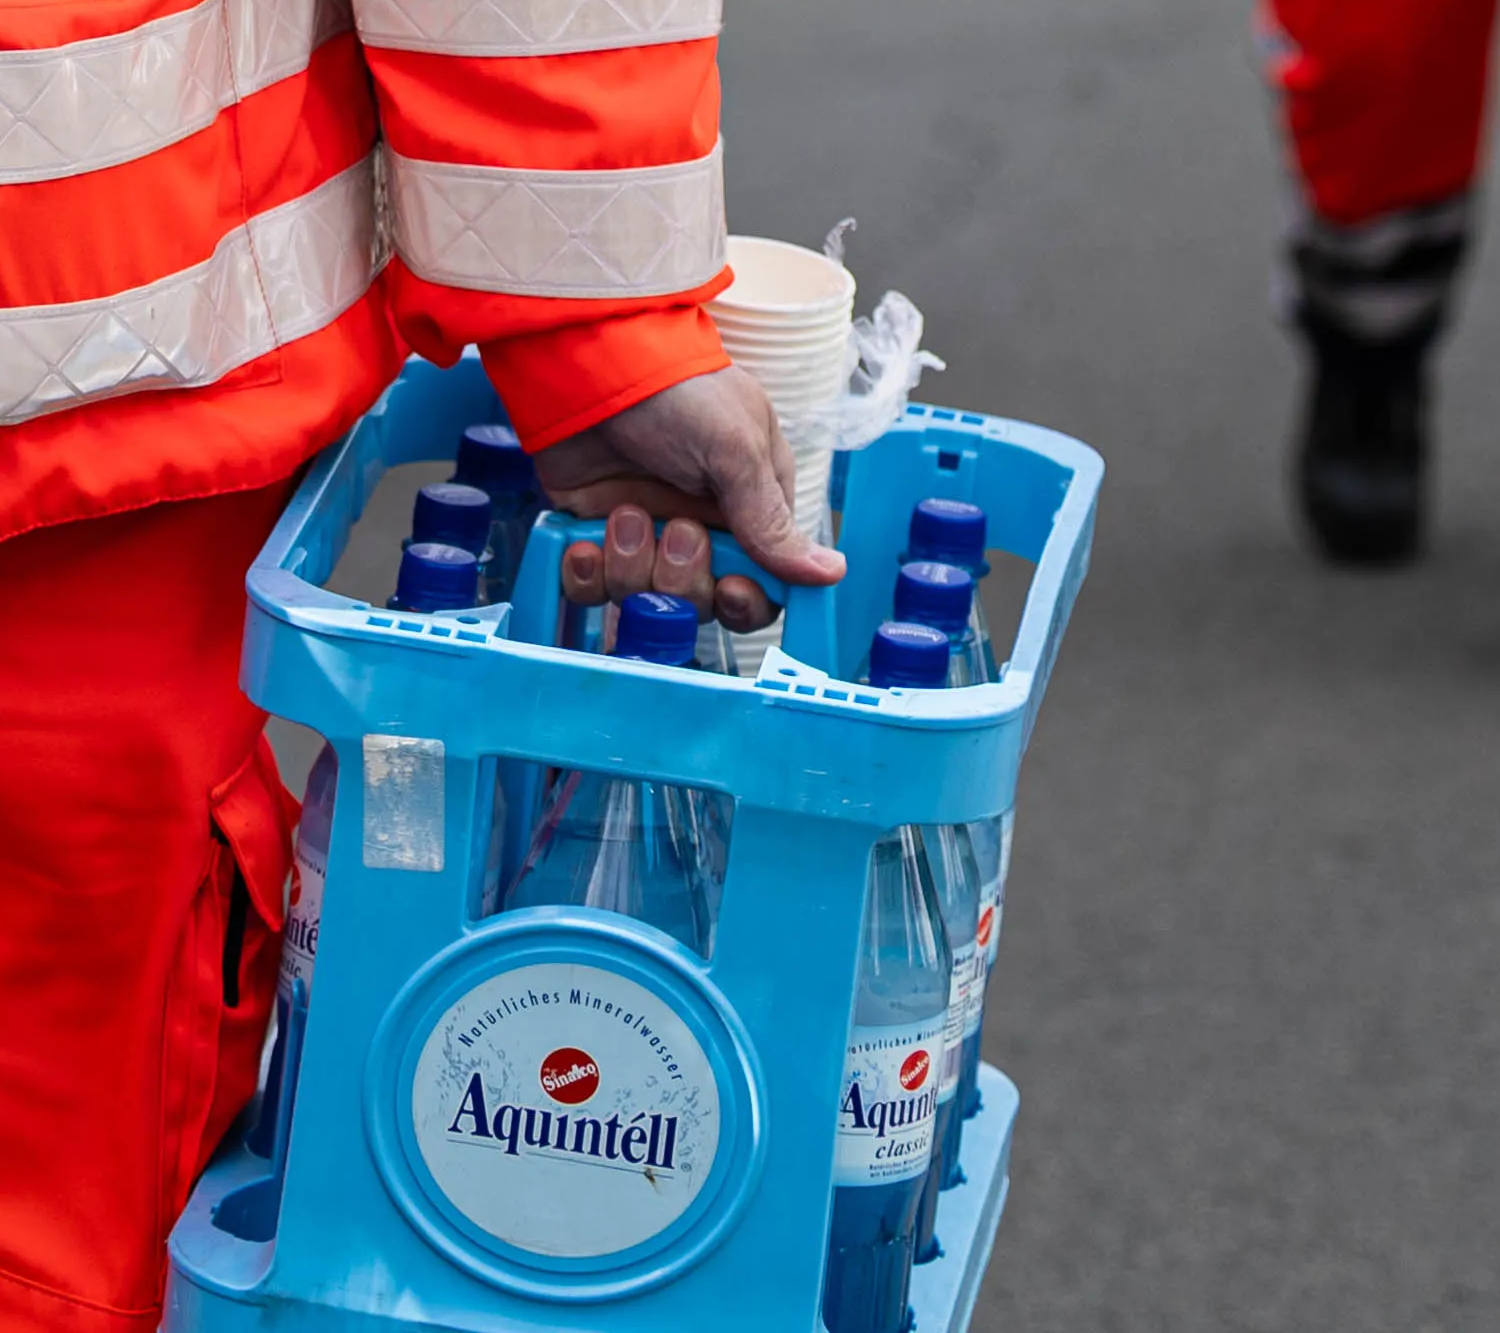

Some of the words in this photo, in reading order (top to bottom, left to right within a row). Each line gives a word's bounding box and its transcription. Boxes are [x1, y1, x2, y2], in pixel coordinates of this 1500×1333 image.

[458, 989, 561, 1048] Natürliches
[569, 988, 683, 1082] Mineralwasser
[848, 1036, 912, 1055] atürliches
[542, 1062, 597, 1092] Sinalco
[447, 1072, 678, 1170] Aquintéll
